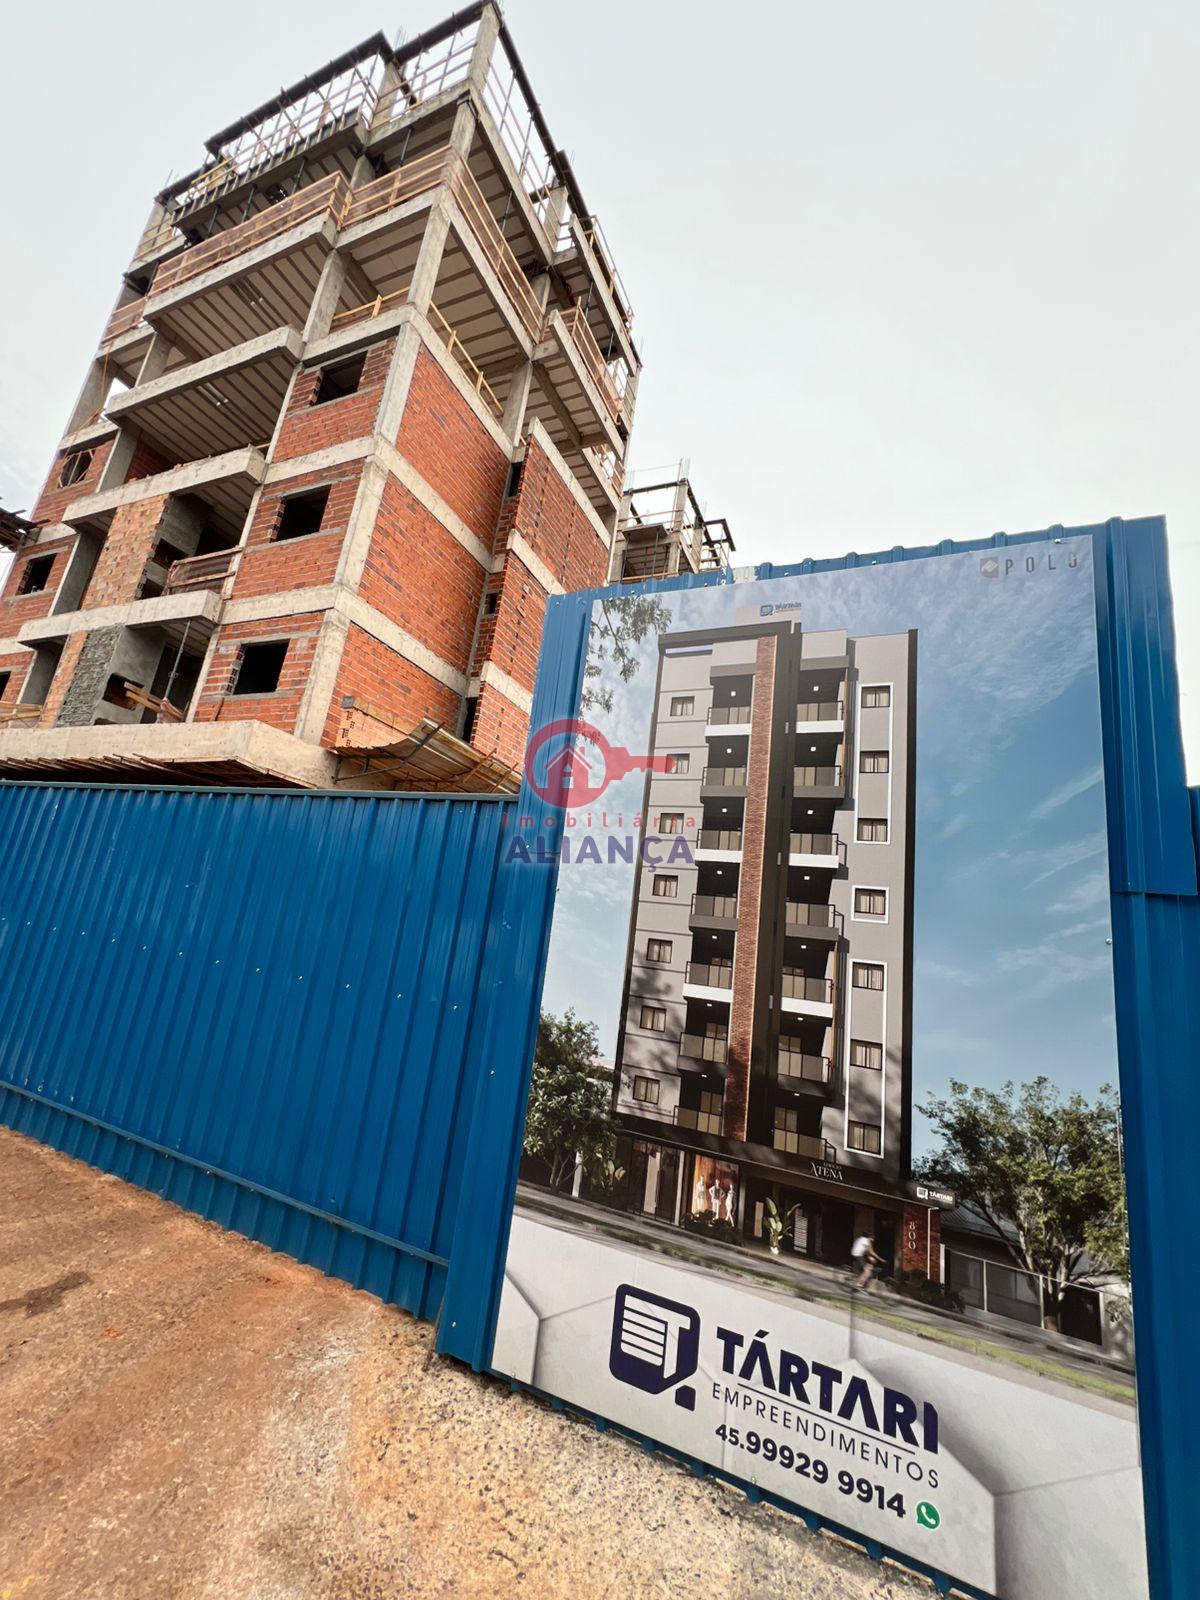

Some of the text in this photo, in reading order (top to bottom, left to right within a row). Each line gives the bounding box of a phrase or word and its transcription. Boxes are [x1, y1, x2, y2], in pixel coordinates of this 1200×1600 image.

[811, 1162, 843, 1181] ATENA
[712, 1382, 939, 1489] EMPREENDIMENTOS
[716, 1326, 939, 1454] TÁRTARI
[715, 1424, 906, 1518] 45.99929 9914
